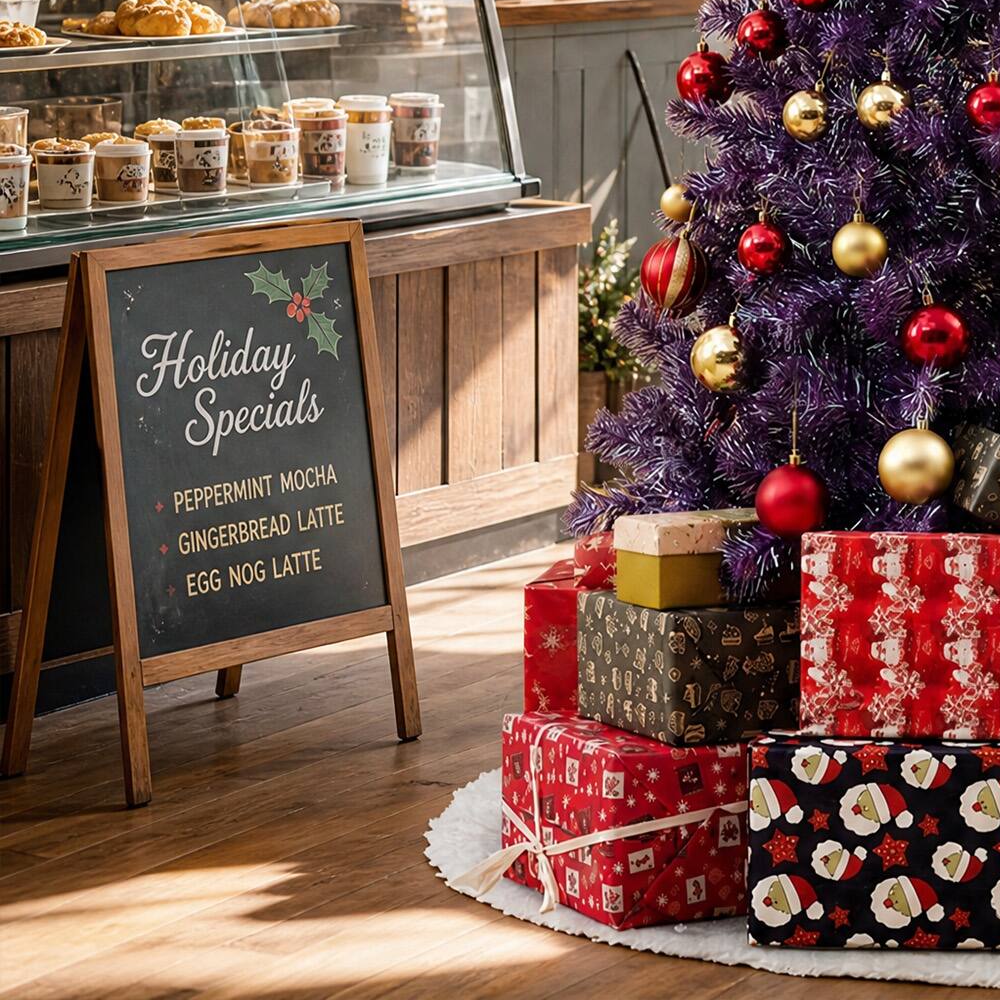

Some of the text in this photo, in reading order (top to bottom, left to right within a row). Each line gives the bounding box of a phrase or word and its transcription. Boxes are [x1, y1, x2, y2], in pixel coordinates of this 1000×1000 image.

[135, 327, 297, 398] Holiday
[185, 377, 324, 457] Specials
[173, 463, 338, 514] PEPPERMINT MOCHA
[178, 503, 345, 556] GINGERBREAD LATTE
[186, 548, 323, 597] EGG NOG LATTE
